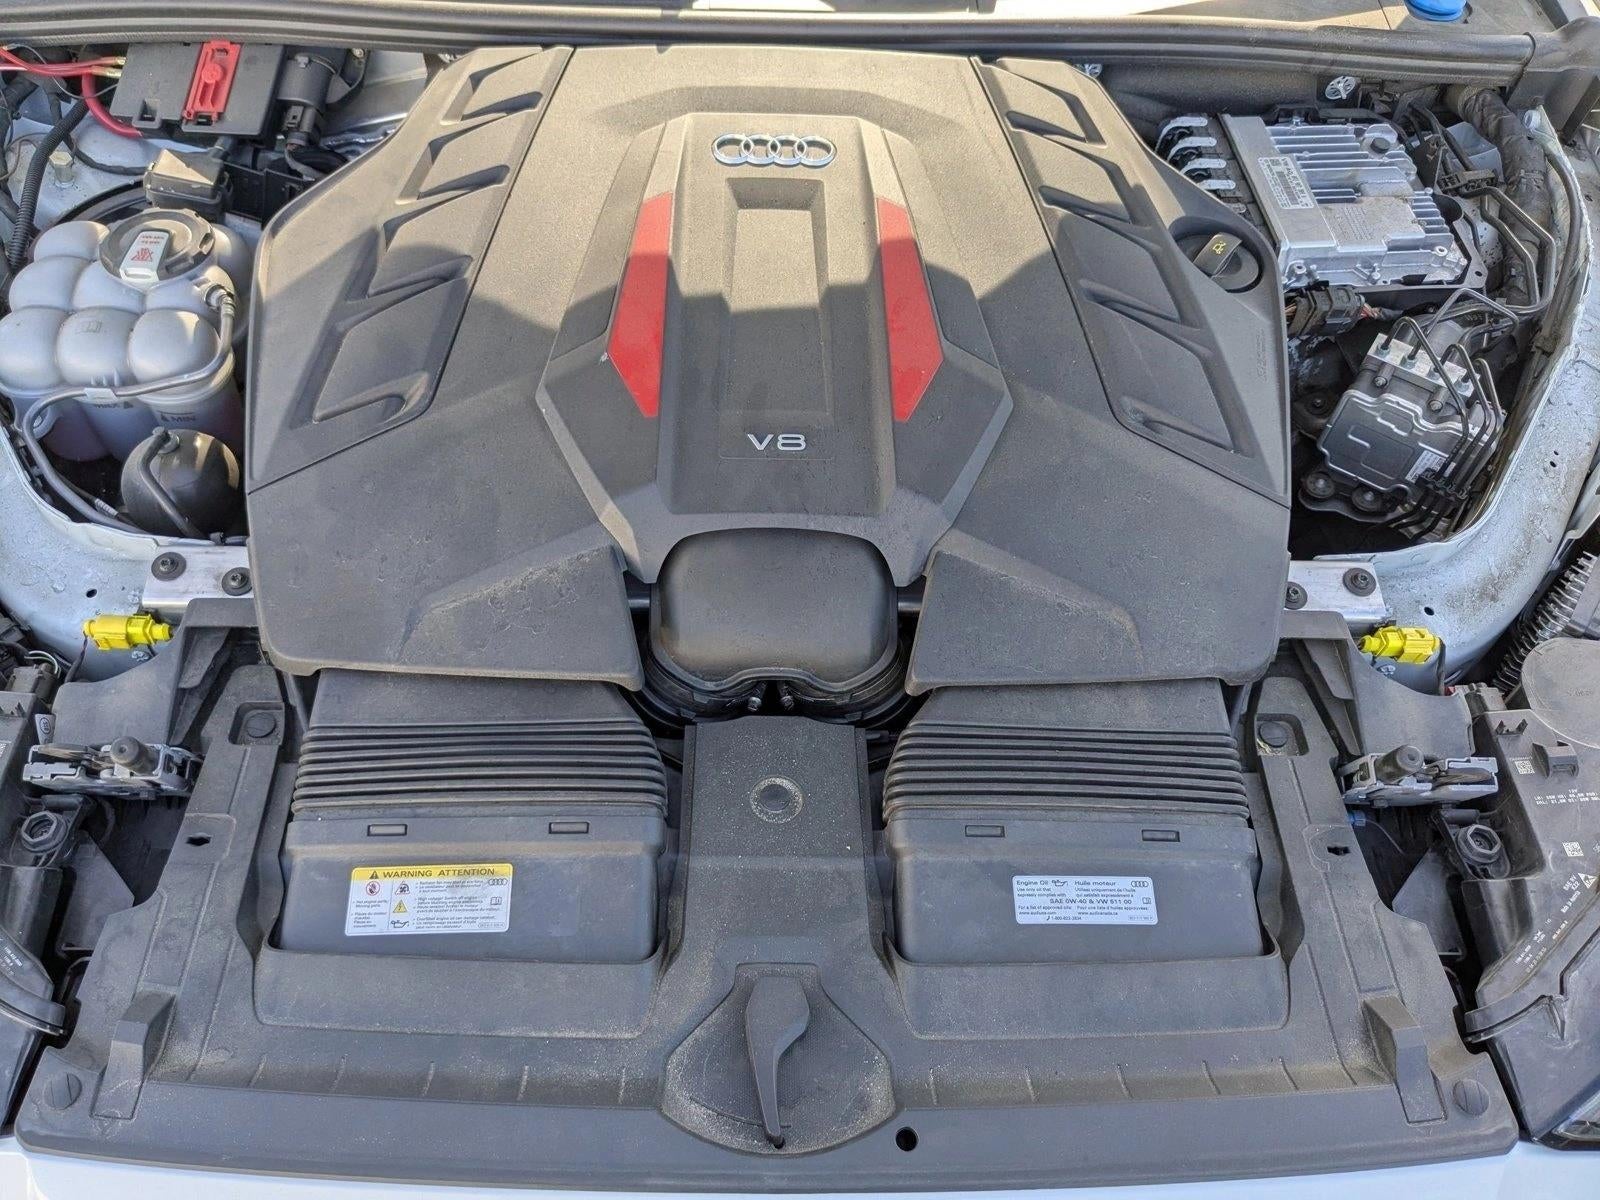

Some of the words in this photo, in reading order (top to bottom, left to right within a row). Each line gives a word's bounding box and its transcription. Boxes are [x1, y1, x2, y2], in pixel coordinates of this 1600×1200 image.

[747, 434, 806, 450] V8
[383, 870, 432, 878] WARNING
[438, 868, 495, 876] ATTENTION
